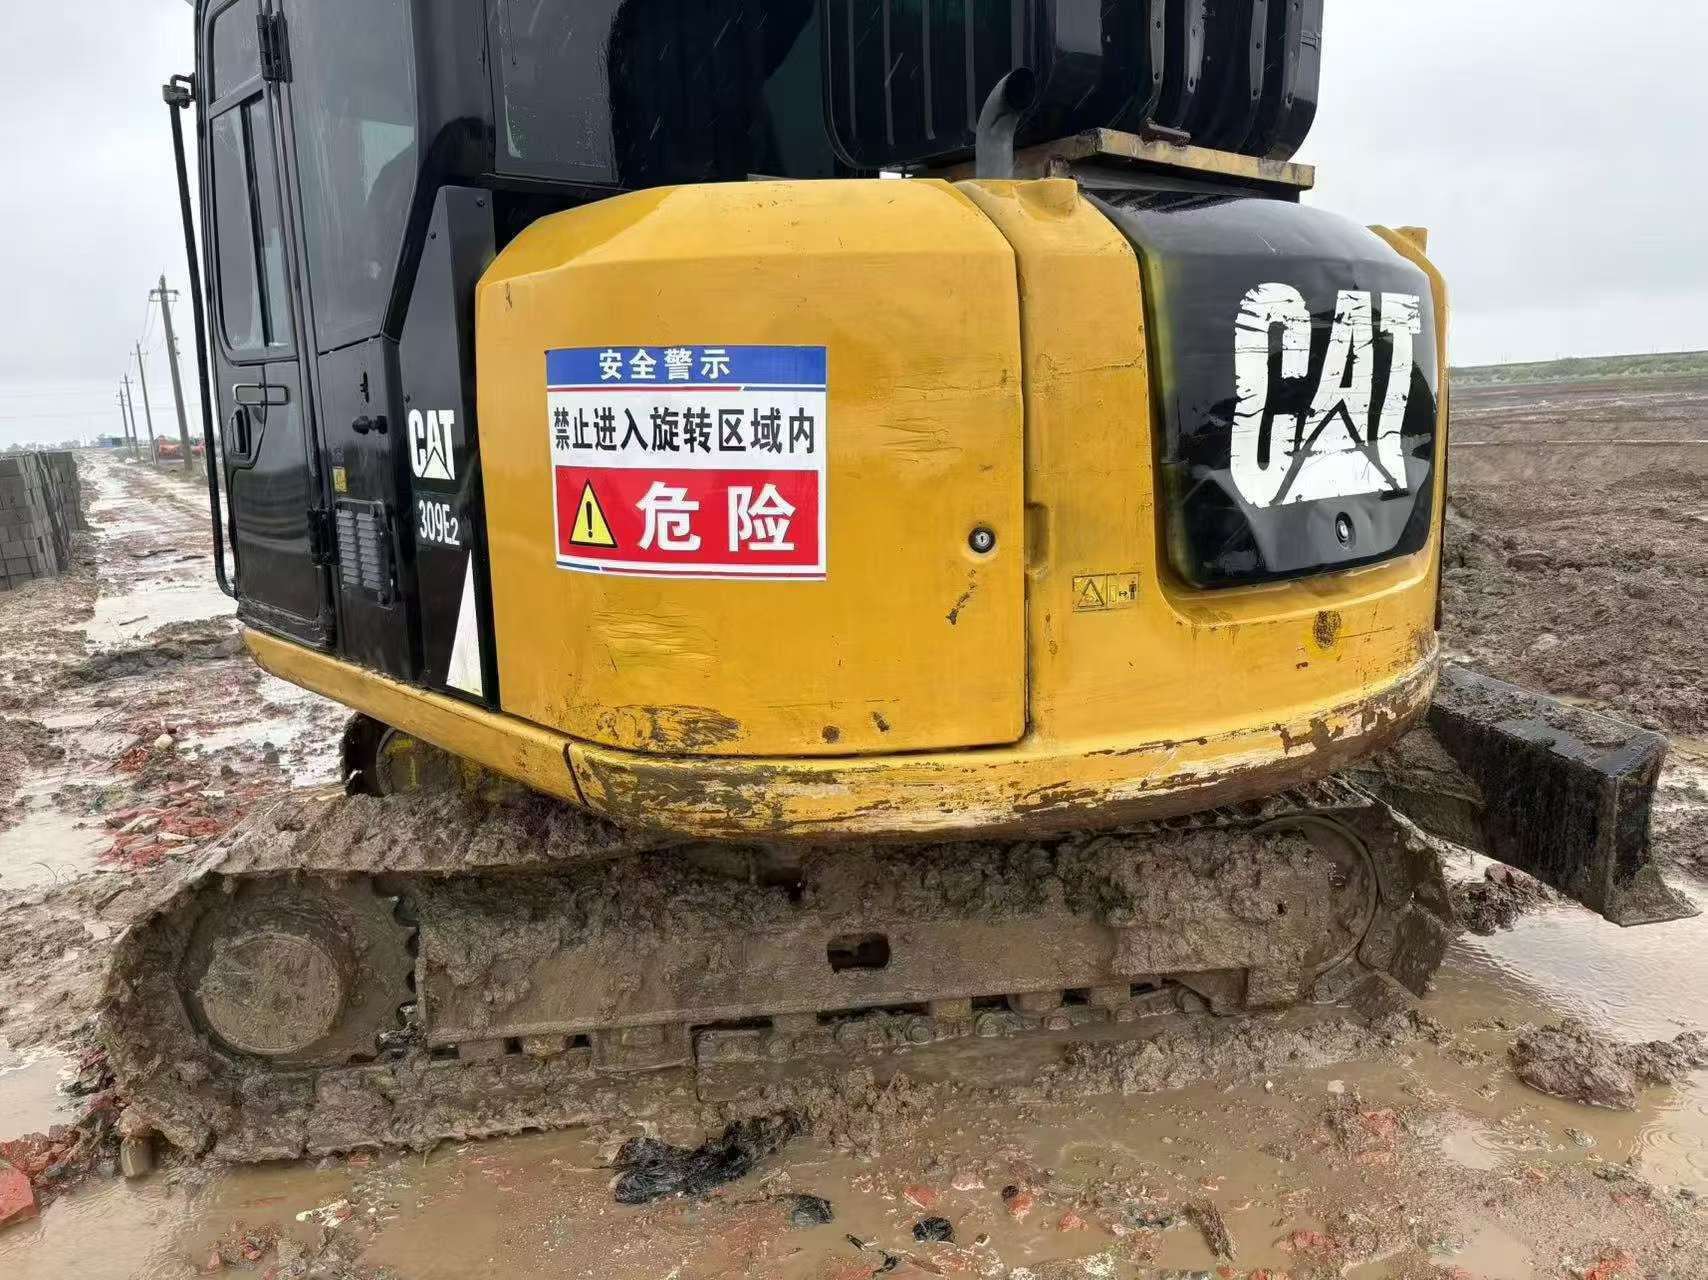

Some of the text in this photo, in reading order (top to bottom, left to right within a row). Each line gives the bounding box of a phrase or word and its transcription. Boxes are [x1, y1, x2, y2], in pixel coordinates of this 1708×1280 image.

[599, 348, 731, 381] 安全警示
[1230, 282, 1421, 508] CAT
[408, 409, 455, 480] CAT
[553, 406, 815, 454] 禁止进入旋转区域内
[418, 499, 460, 546] 309E2
[635, 480, 796, 553] 危险
